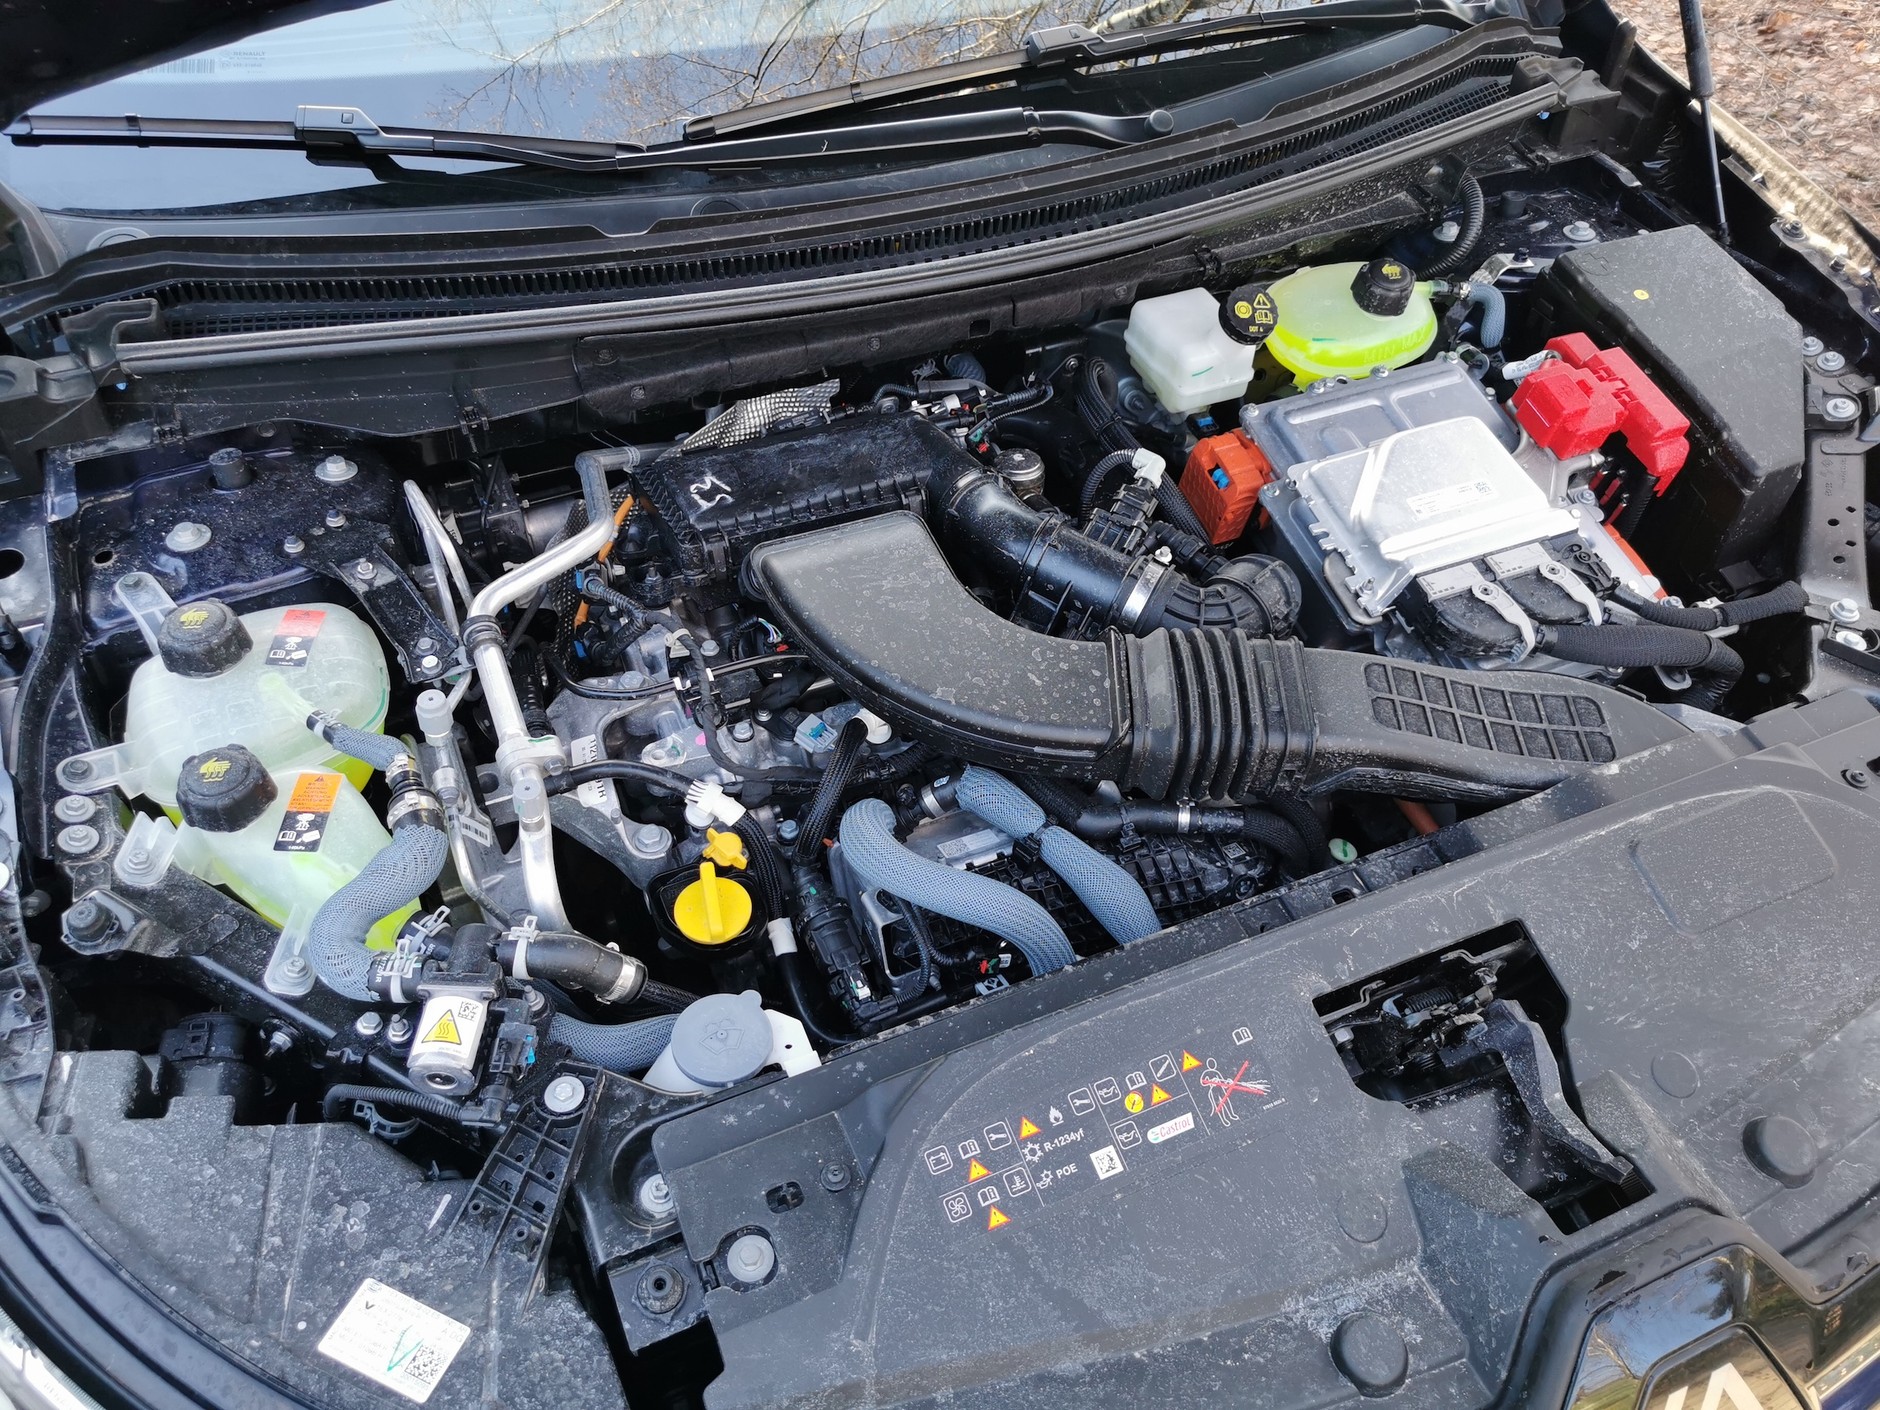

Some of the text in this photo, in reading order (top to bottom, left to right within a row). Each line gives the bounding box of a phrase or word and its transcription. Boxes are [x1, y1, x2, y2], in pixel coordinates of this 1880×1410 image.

[1363, 325, 1427, 364] MIN MAX
[1159, 1116, 1191, 1138] Castrol
[1043, 1127, 1085, 1152] R-1234yf
[1055, 1163, 1078, 1179] POE
